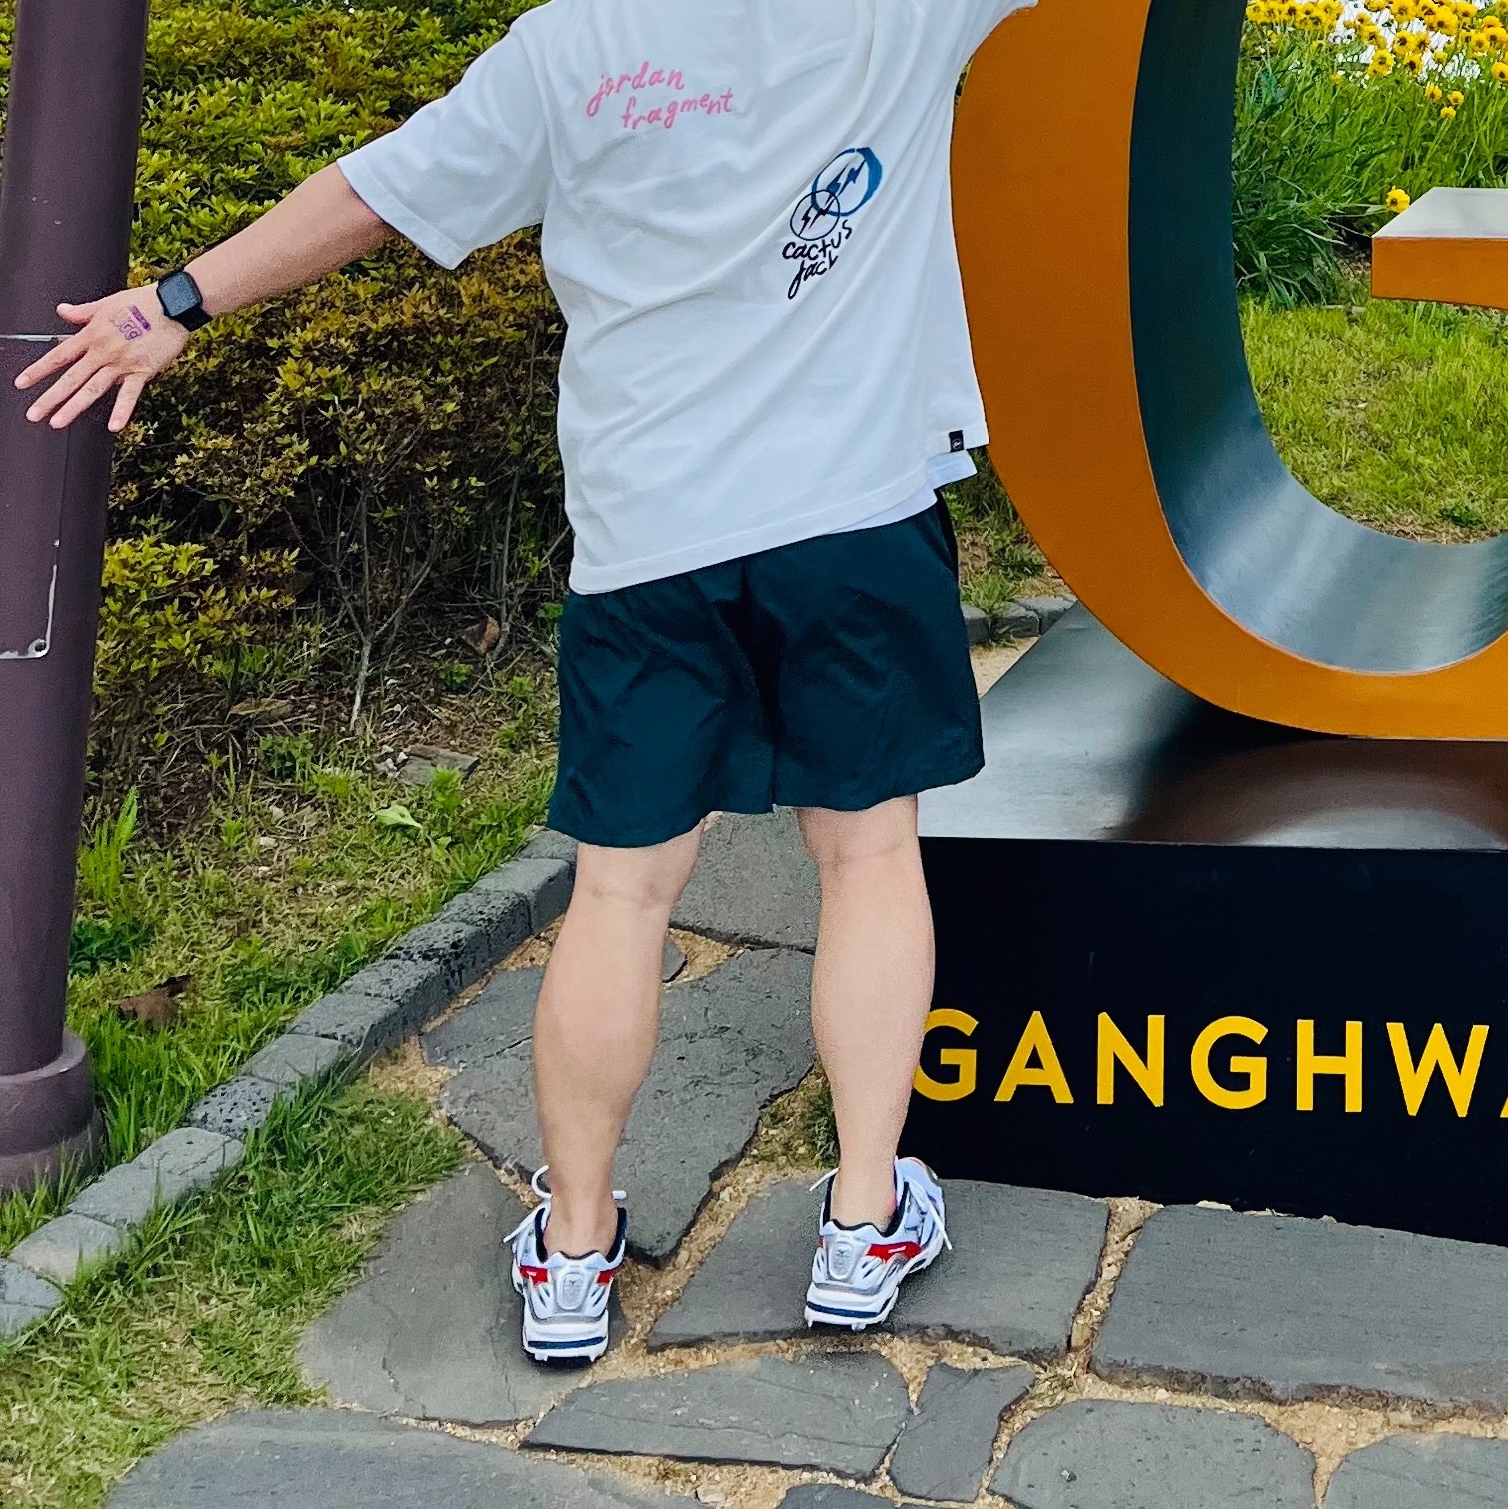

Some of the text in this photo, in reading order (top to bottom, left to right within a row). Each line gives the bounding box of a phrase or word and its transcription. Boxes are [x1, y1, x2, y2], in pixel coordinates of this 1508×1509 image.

[586, 60, 685, 118] jordan
[620, 87, 734, 130] fragment
[781, 218, 853, 261] cactus
